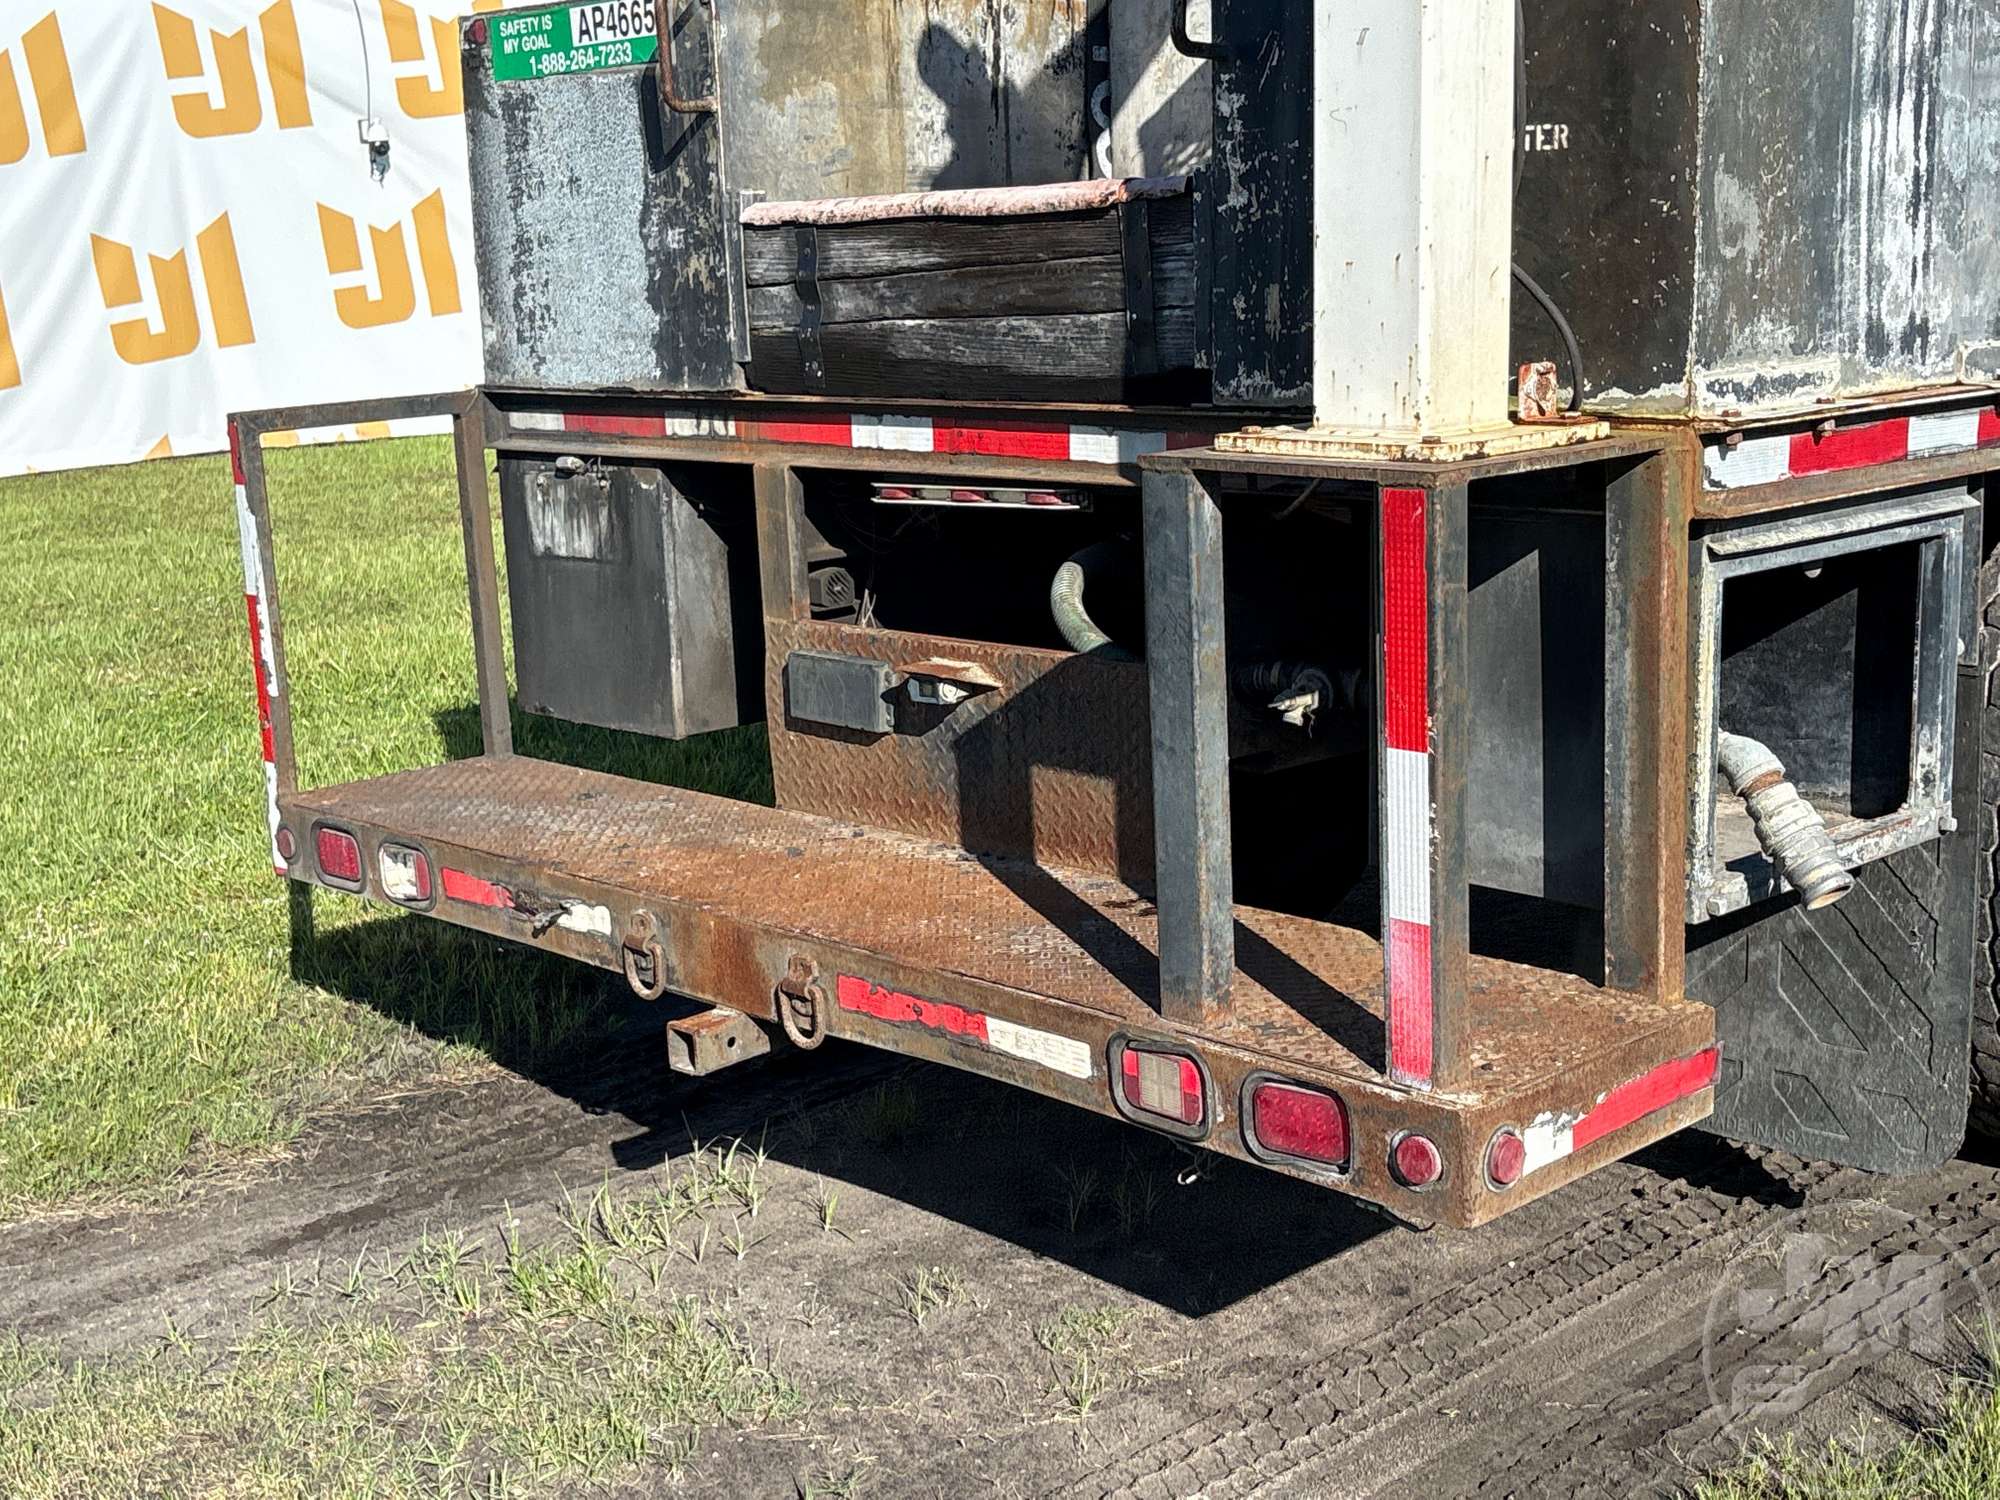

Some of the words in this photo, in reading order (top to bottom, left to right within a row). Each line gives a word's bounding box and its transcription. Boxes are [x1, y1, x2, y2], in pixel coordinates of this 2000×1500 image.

[499, 15, 540, 38] SAFETY
[541, 14, 553, 32] IS
[578, 0, 655, 44] AP4665
[503, 37, 520, 55] MY
[521, 34, 552, 52] GOAL
[528, 41, 633, 76] 1-888-264-7233
